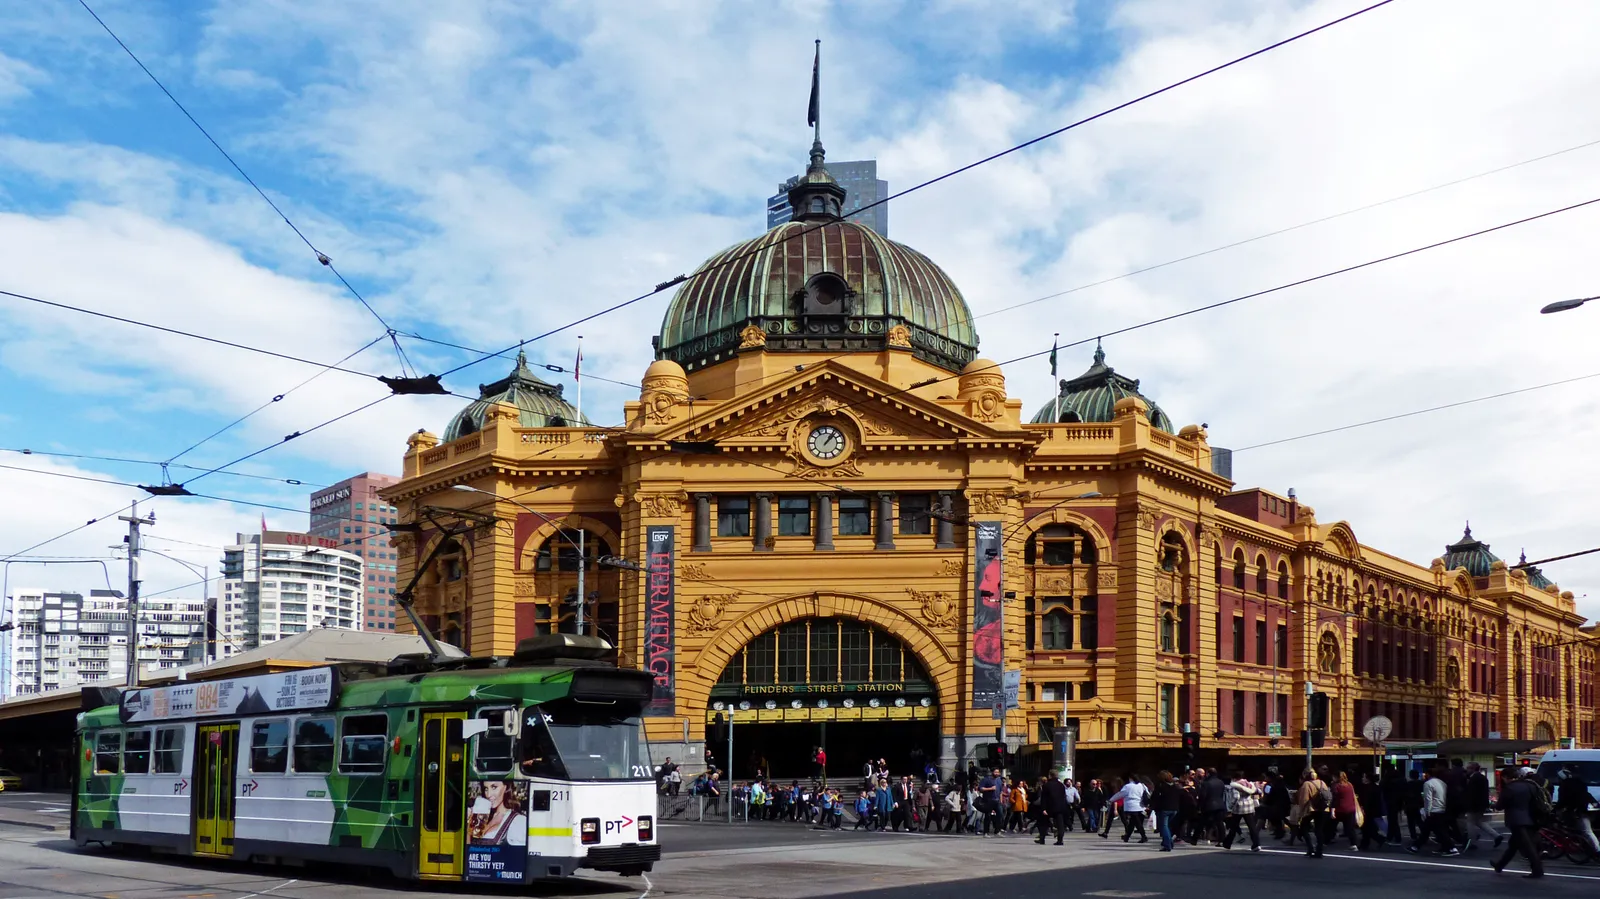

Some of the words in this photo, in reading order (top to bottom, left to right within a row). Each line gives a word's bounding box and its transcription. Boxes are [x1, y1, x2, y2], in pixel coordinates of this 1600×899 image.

[311, 494, 335, 509] HERALD
[336, 488, 350, 500] SUN
[286, 534, 313, 545] QUAY
[318, 538, 337, 549] WEST
[655, 534, 669, 542] ngv
[650, 552, 670, 687] HERMITAGE
[302, 675, 315, 686] BOOK
[315, 674, 328, 684] NOW
[745, 685, 794, 694] FLINDERS
[807, 684, 845, 693] STREET
[857, 683, 903, 692] STATION
[196, 683, 219, 710] 1984
[276, 697, 296, 708] OCTOBER
[632, 765, 652, 777] 211
[552, 791, 570, 801] 211
[469, 854, 480, 862] ARE
[480, 854, 491, 862] YOU
[469, 861, 491, 870] THIRSTY
[492, 862, 505, 870] YET?
